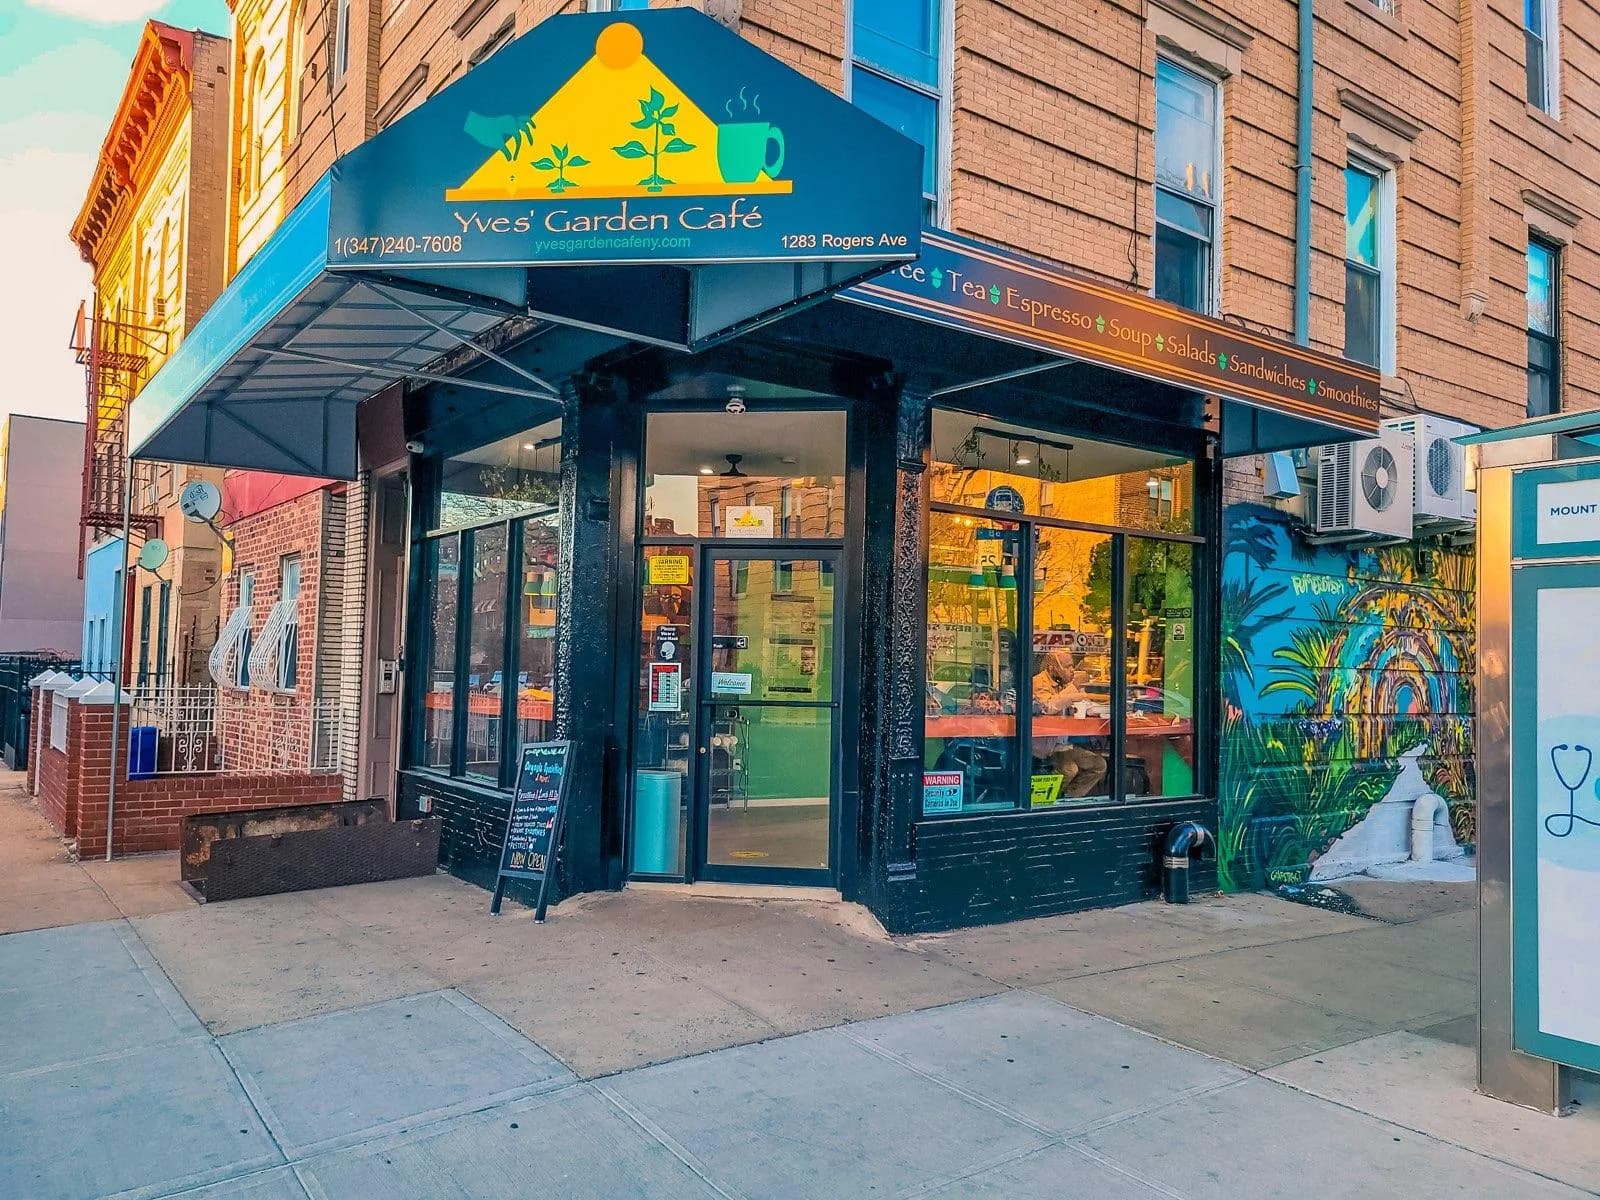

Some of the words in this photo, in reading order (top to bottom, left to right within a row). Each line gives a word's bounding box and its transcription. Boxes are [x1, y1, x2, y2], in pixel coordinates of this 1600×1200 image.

[454, 209, 535, 234] Yves'
[544, 200, 668, 232] Garden
[678, 198, 763, 230] Café
[333, 235, 463, 258] 1(347)240-7608
[535, 235, 691, 254] yvesgardencafeny.com
[781, 234, 816, 249] 1283
[822, 234, 875, 250] Rogers
[879, 233, 907, 247] Ave
[946, 269, 987, 301] Tea
[1006, 287, 1093, 330] Espresso
[1108, 319, 1152, 356] Soup
[1166, 334, 1217, 366] Salads
[1229, 354, 1306, 392] Sandwiches
[1317, 380, 1379, 412] Smoothies
[1550, 504, 1598, 516] MOUNT
[718, 677, 745, 687] Welcome
[925, 775, 960, 785] WARNING
[527, 852, 547, 870] OPEN
